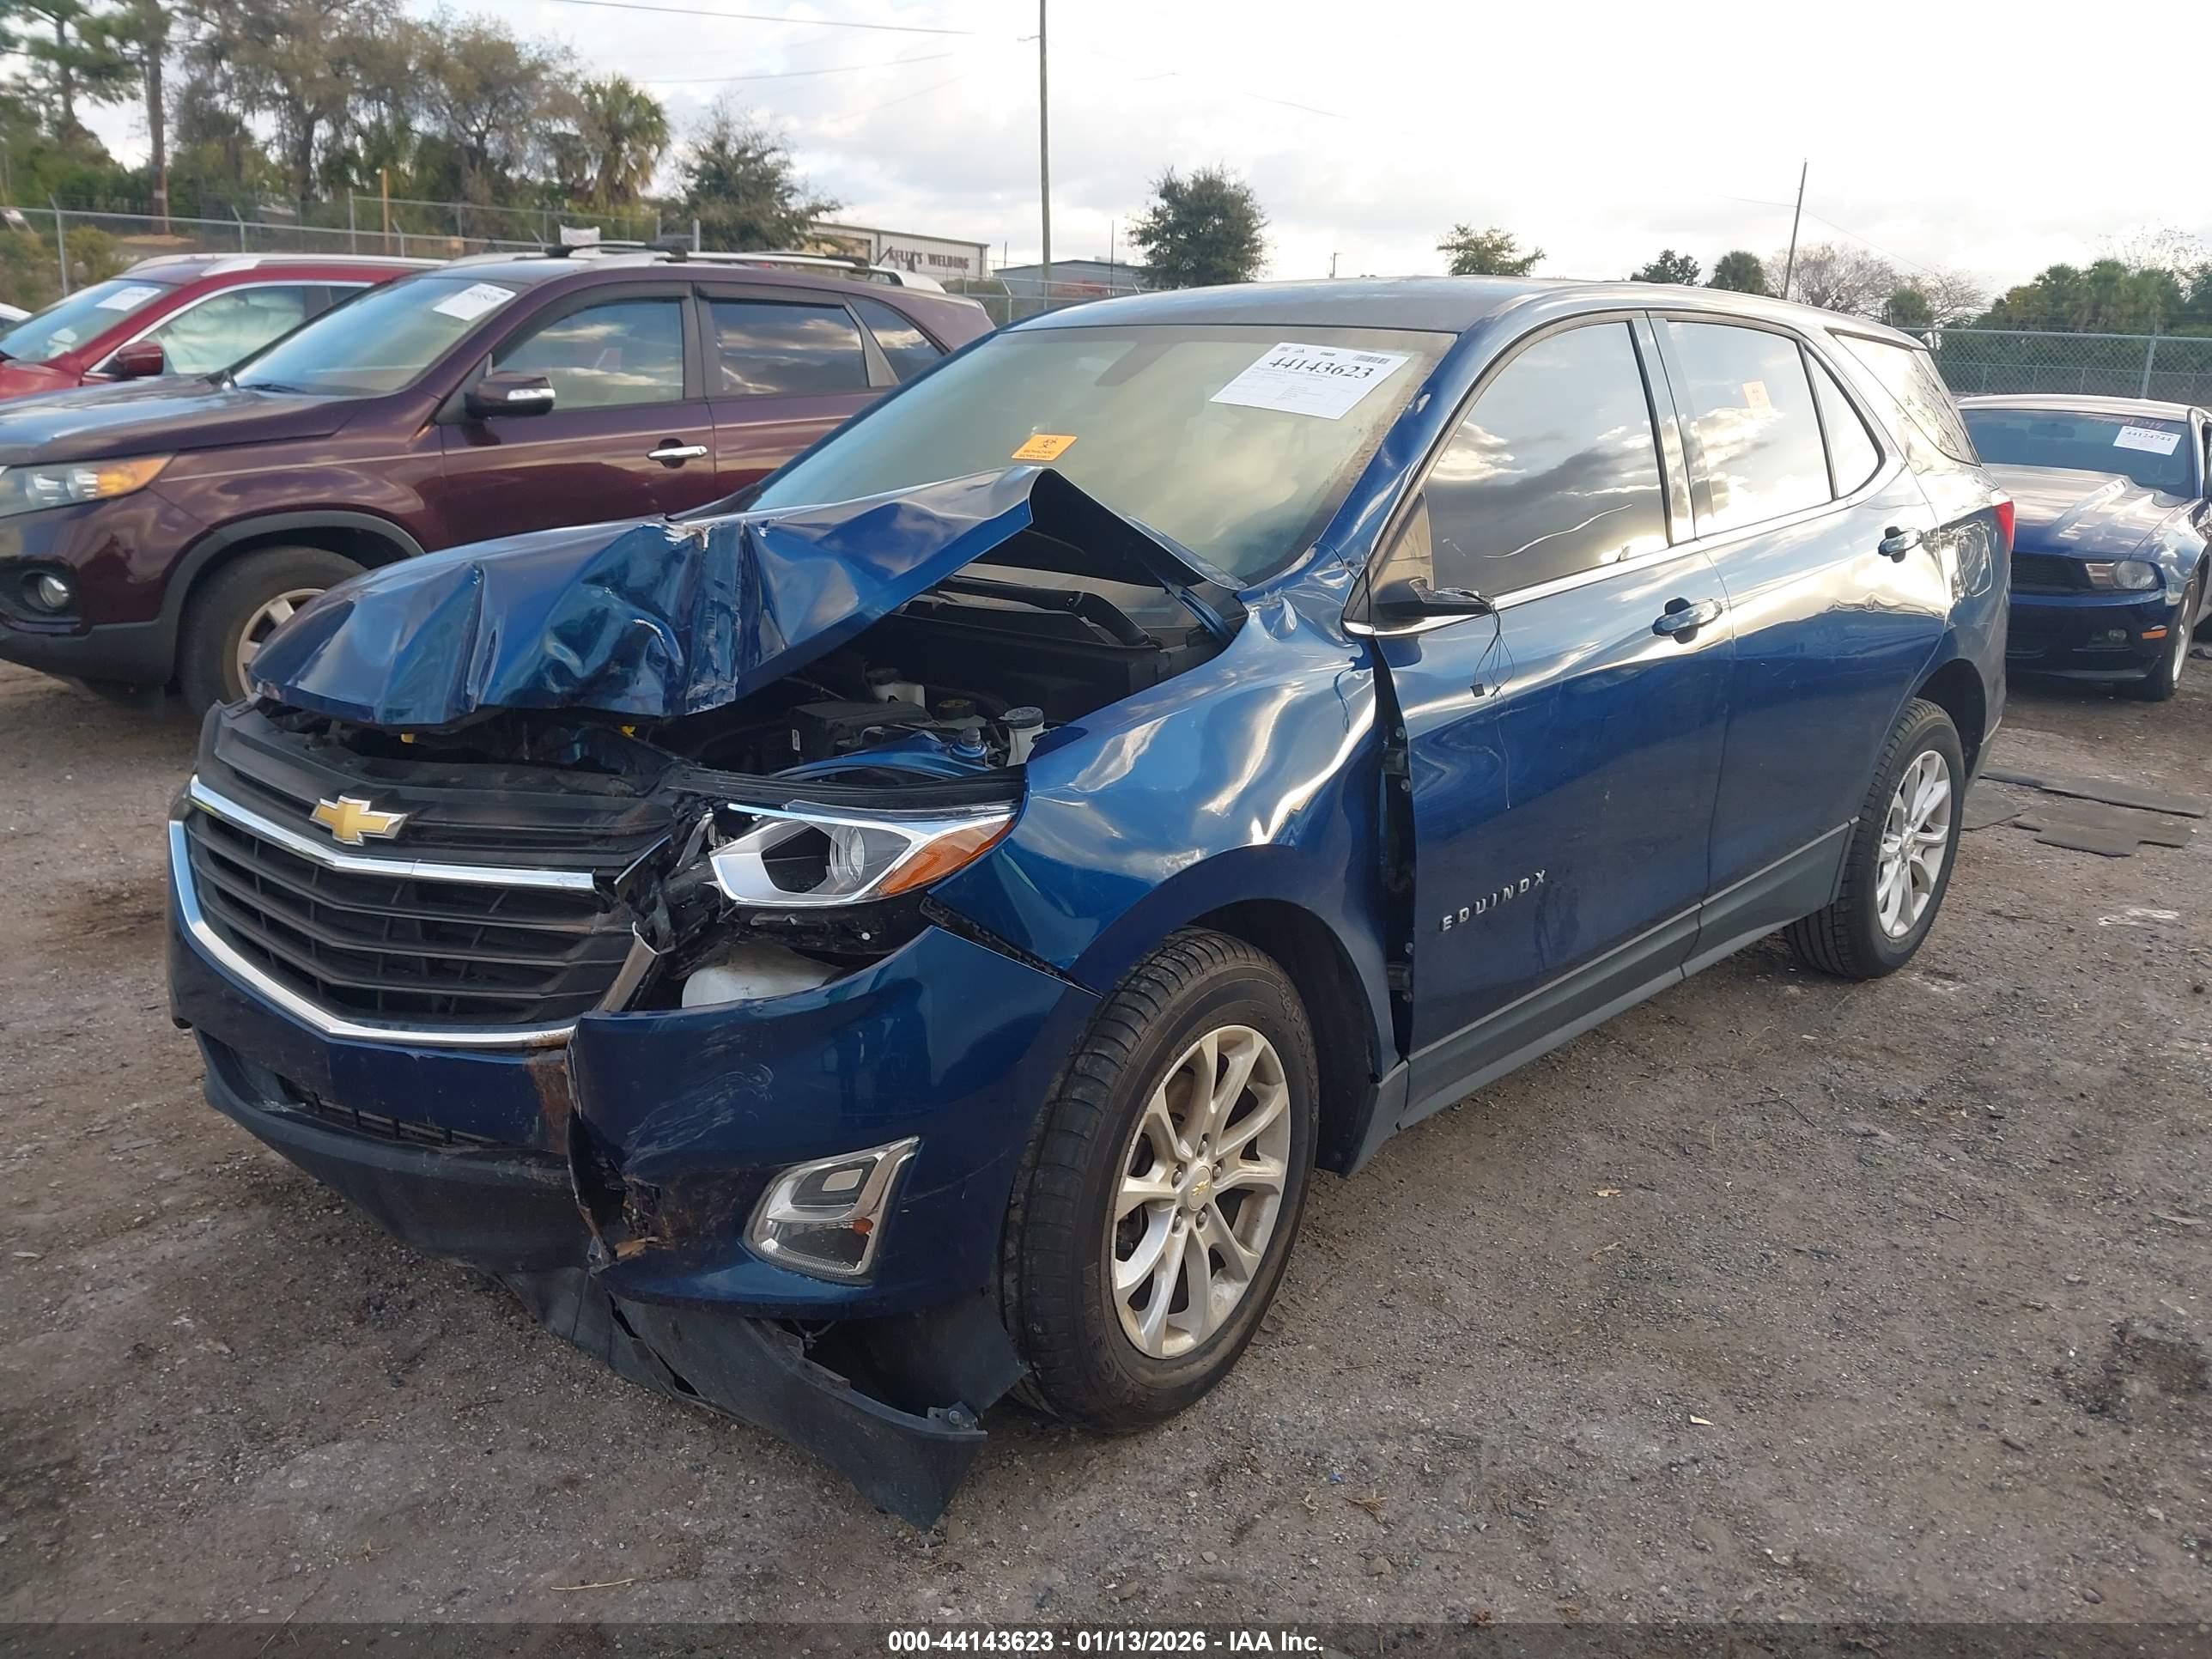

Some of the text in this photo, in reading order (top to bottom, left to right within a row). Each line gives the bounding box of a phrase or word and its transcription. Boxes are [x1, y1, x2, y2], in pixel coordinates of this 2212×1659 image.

[927, 252, 969, 270] WELDING
[1268, 356, 1375, 380] 44143623
[1442, 869, 1547, 932] EQUINOX
